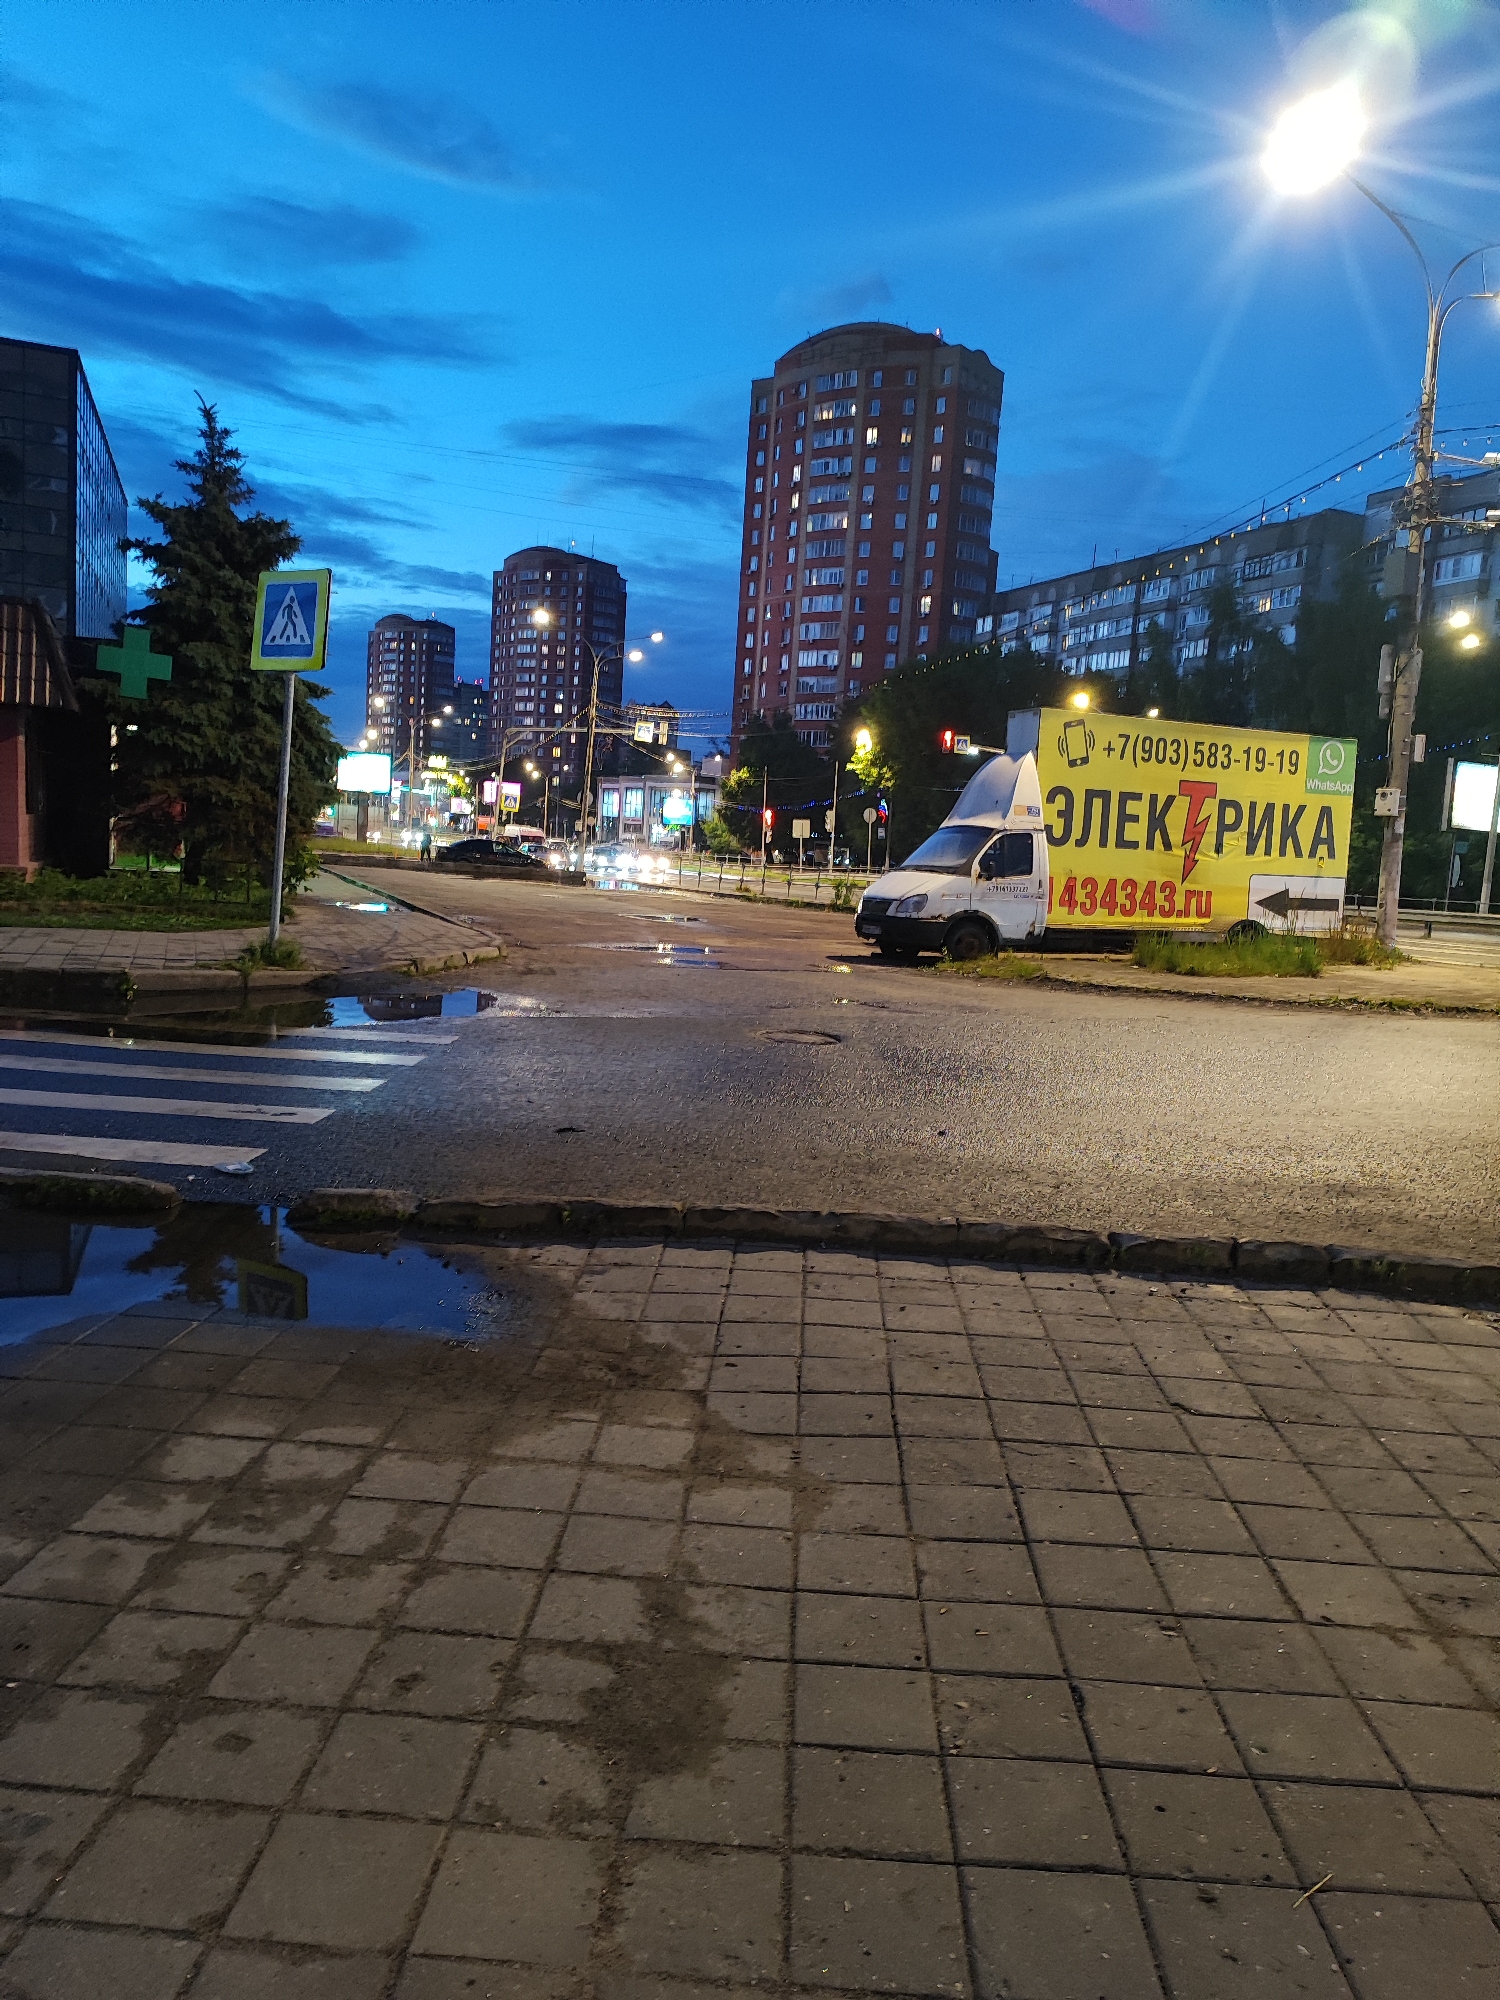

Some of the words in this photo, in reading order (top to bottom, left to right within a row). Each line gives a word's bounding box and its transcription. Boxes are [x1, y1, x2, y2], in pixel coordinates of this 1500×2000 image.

[1102, 733, 1300, 775] +7(903)583-19-19
[1305, 778, 1354, 795] WhatsApp
[1046, 780, 1336, 884] ЭЛЕКТРИКА
